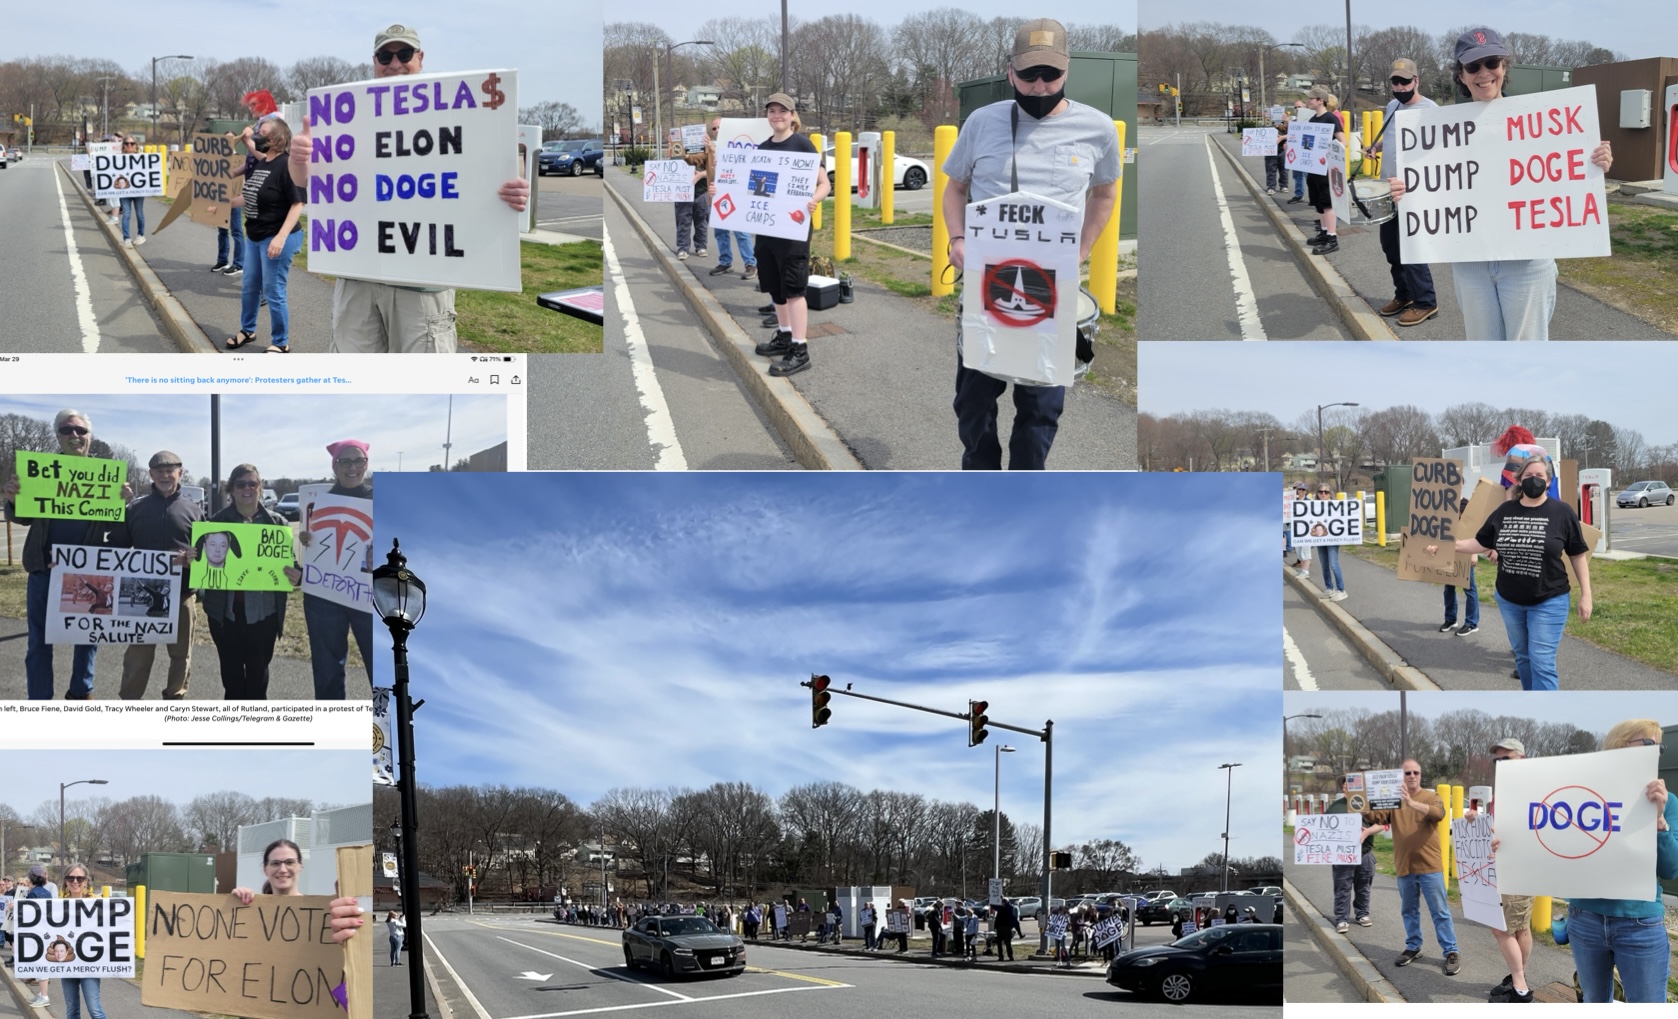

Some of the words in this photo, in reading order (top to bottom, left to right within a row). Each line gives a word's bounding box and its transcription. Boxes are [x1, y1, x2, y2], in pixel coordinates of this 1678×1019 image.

[309, 91, 356, 127] NO
[1401, 120, 1476, 151] DUMP
[1506, 105, 1585, 142] MUSK
[194, 136, 234, 157] CURB
[311, 134, 355, 163] NO
[375, 126, 462, 158] ELON
[95, 153, 161, 171] DUMP
[193, 158, 232, 180] YOUR
[649, 162, 661, 171] SAY
[663, 161, 678, 173] NO
[722, 153, 746, 164] NEVER
[778, 156, 790, 166] IS
[792, 158, 815, 168] NOW!
[1404, 160, 1480, 193] DUMP
[1509, 148, 1586, 186] DOGE
[311, 173, 358, 204] NO
[375, 172, 459, 202] DOGE
[790, 175, 810, 185] THEY
[193, 179, 231, 203] DOGE
[745, 211, 776, 227] CAMPS
[998, 204, 1046, 224] FECK
[1406, 205, 1478, 237] DUMP
[1507, 192, 1601, 231] TESLA
[311, 219, 358, 252] NO
[377, 220, 464, 258] EVIL
[969, 226, 1076, 244] TUSLA
[151, 376, 157, 384] is
[170, 376, 195, 385] sitting
[197, 376, 215, 384] back
[255, 376, 295, 384] Protesters
[296, 376, 321, 385] gather
[27, 459, 62, 479] Bet
[69, 468, 94, 483] you
[97, 464, 120, 483] did
[1413, 461, 1461, 486] CURB
[56, 480, 111, 499] NAZI
[34, 497, 75, 515] This
[79, 500, 122, 520] Coming
[1293, 500, 1360, 518] DUMP
[1412, 487, 1458, 514] YOUR
[261, 528, 285, 544] BAD
[1410, 513, 1455, 542] DOGE
[56, 547, 87, 569] NO
[96, 548, 181, 576] EXCUSE
[257, 544, 294, 559] DOGE!
[305, 563, 369, 601] DEPORT
[64, 616, 104, 631] FOR
[110, 619, 130, 628] THE
[134, 622, 173, 634] NAZI
[88, 631, 144, 643] SALUTE
[4, 705, 18, 713] left,
[41, 705, 62, 713] Fiene,
[85, 705, 103, 713] Gold,
[105, 705, 123, 713] Tracy
[170, 705, 190, 713] Caryn
[191, 705, 221, 713] Stewart,
[241, 705, 270, 713] Rutland,
[271, 705, 314, 713] participated
[164, 715, 189, 723] (Photo:
[211, 715, 275, 723] Collings/Telegram
[282, 715, 313, 723] Gazette)
[1301, 817, 1316, 826] SAY
[1320, 815, 1339, 829] NO
[1528, 801, 1623, 832] DOGE
[1311, 831, 1352, 840] NAZIS
[1305, 844, 1331, 853] TESLA
[1336, 845, 1357, 854] MUST
[1306, 853, 1332, 863] FIRE
[1336, 853, 1358, 863] MUSK
[17, 898, 131, 928] DUMP
[102, 965, 132, 973] FLUSH?
[160, 955, 226, 994] FOR
[242, 962, 345, 1008] ELON
